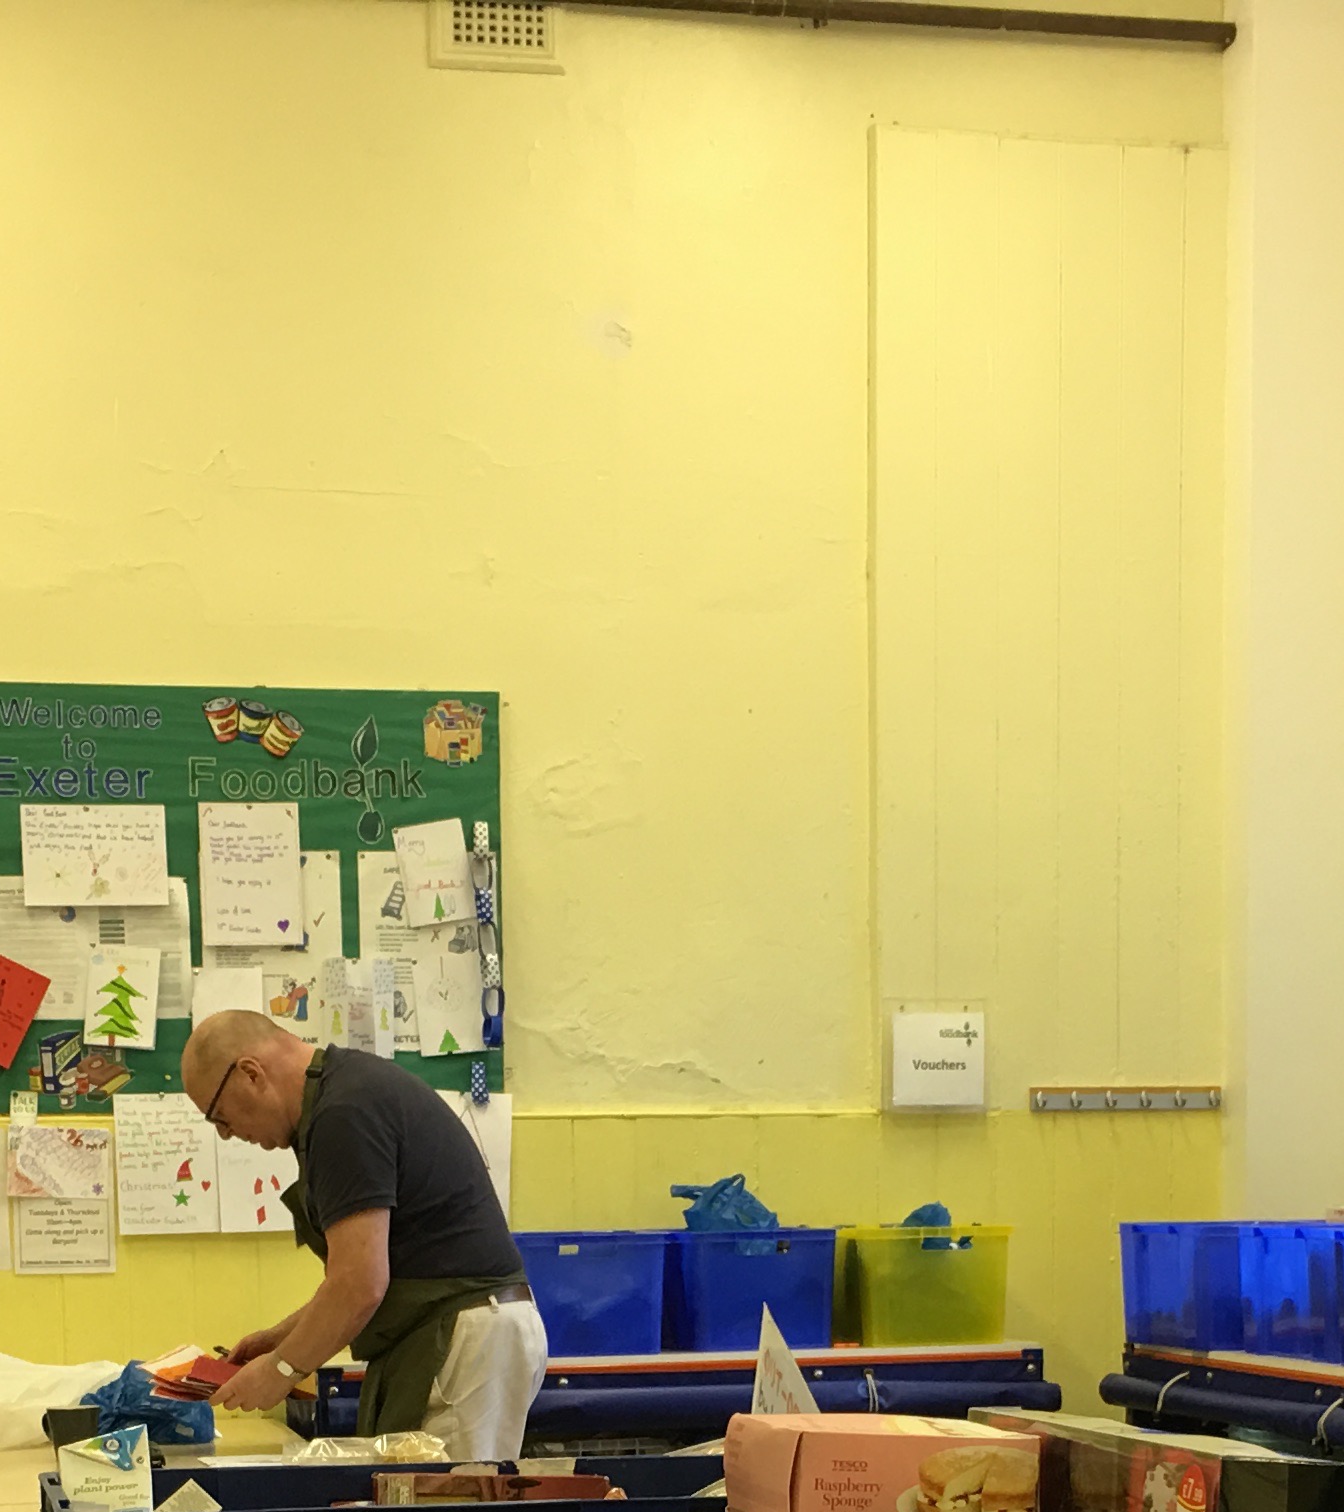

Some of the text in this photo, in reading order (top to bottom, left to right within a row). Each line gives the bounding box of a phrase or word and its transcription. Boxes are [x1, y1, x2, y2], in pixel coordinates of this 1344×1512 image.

[62, 732, 97, 761] to
[188, 756, 426, 799] Foodbank
[912, 1059, 967, 1071] Vouchers
[76, 1228, 88, 1236] pick
[831, 1460, 868, 1470] TESCO
[84, 1477, 111, 1485] Enjoy
[814, 1477, 883, 1497] Raspberry
[73, 1483, 139, 1495] plant power
[822, 1493, 872, 1511] Sponge
